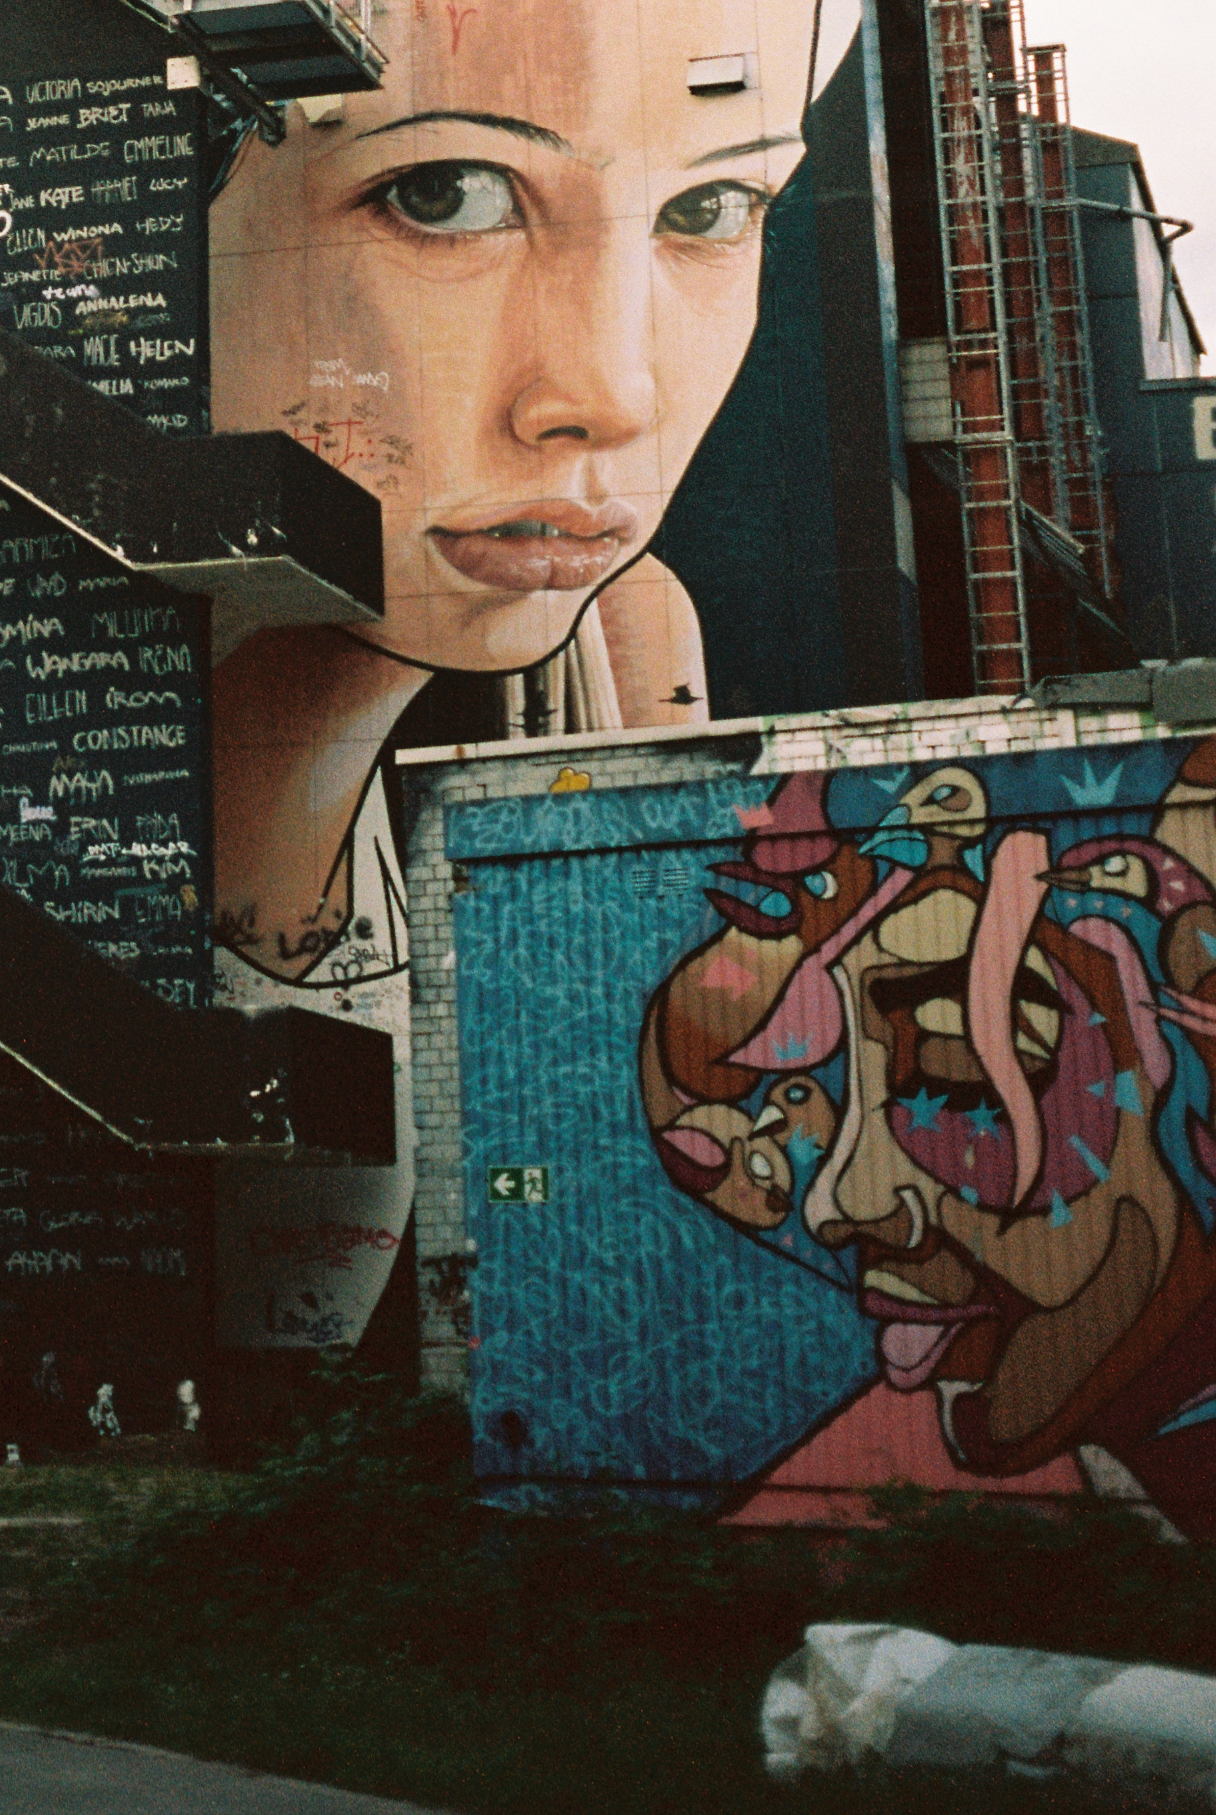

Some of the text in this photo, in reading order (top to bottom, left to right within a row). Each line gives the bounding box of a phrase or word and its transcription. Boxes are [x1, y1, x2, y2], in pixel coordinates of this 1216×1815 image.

[26, 77, 82, 104] VICTORIA
[86, 75, 164, 96] SOJOURNER
[25, 114, 71, 131] JEANNE
[29, 141, 111, 167] MATILDE
[39, 185, 86, 209] KATE
[53, 222, 124, 243] WINONA
[136, 213, 184, 235] HEDY
[130, 336, 195, 364] HELEN
[72, 723, 186, 752] CONSTANCE
[142, 858, 192, 880] KIM
